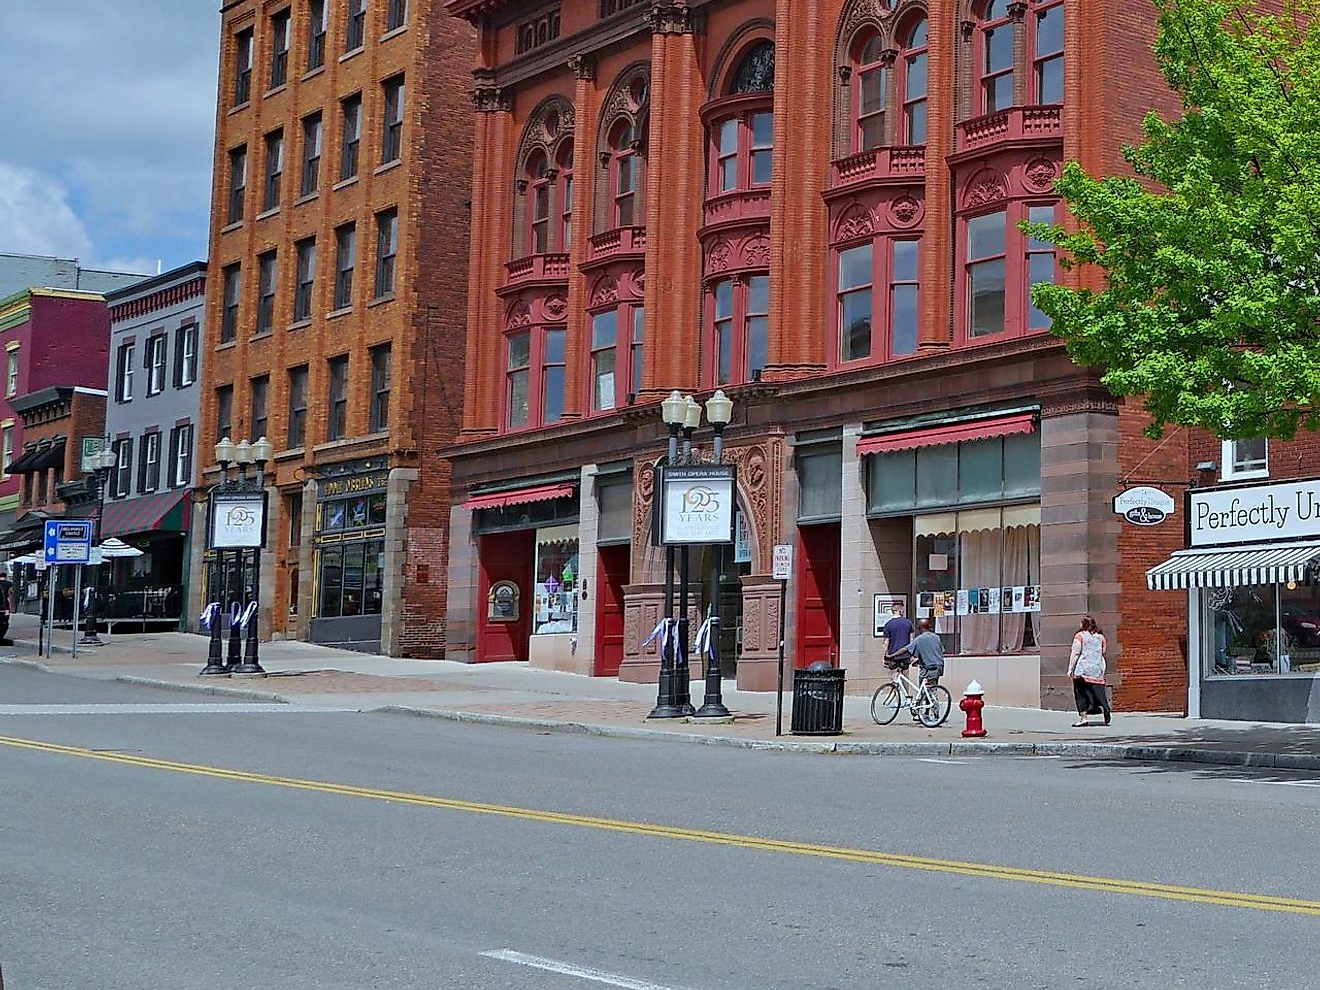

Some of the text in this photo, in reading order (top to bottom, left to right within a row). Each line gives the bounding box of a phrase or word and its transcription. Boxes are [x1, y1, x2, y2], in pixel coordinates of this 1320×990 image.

[679, 486, 720, 514] 125
[226, 506, 255, 526] 125
[678, 514, 719, 523] YEARS
[1140, 508, 1150, 522] &
[1196, 494, 1291, 531] Perfectly
